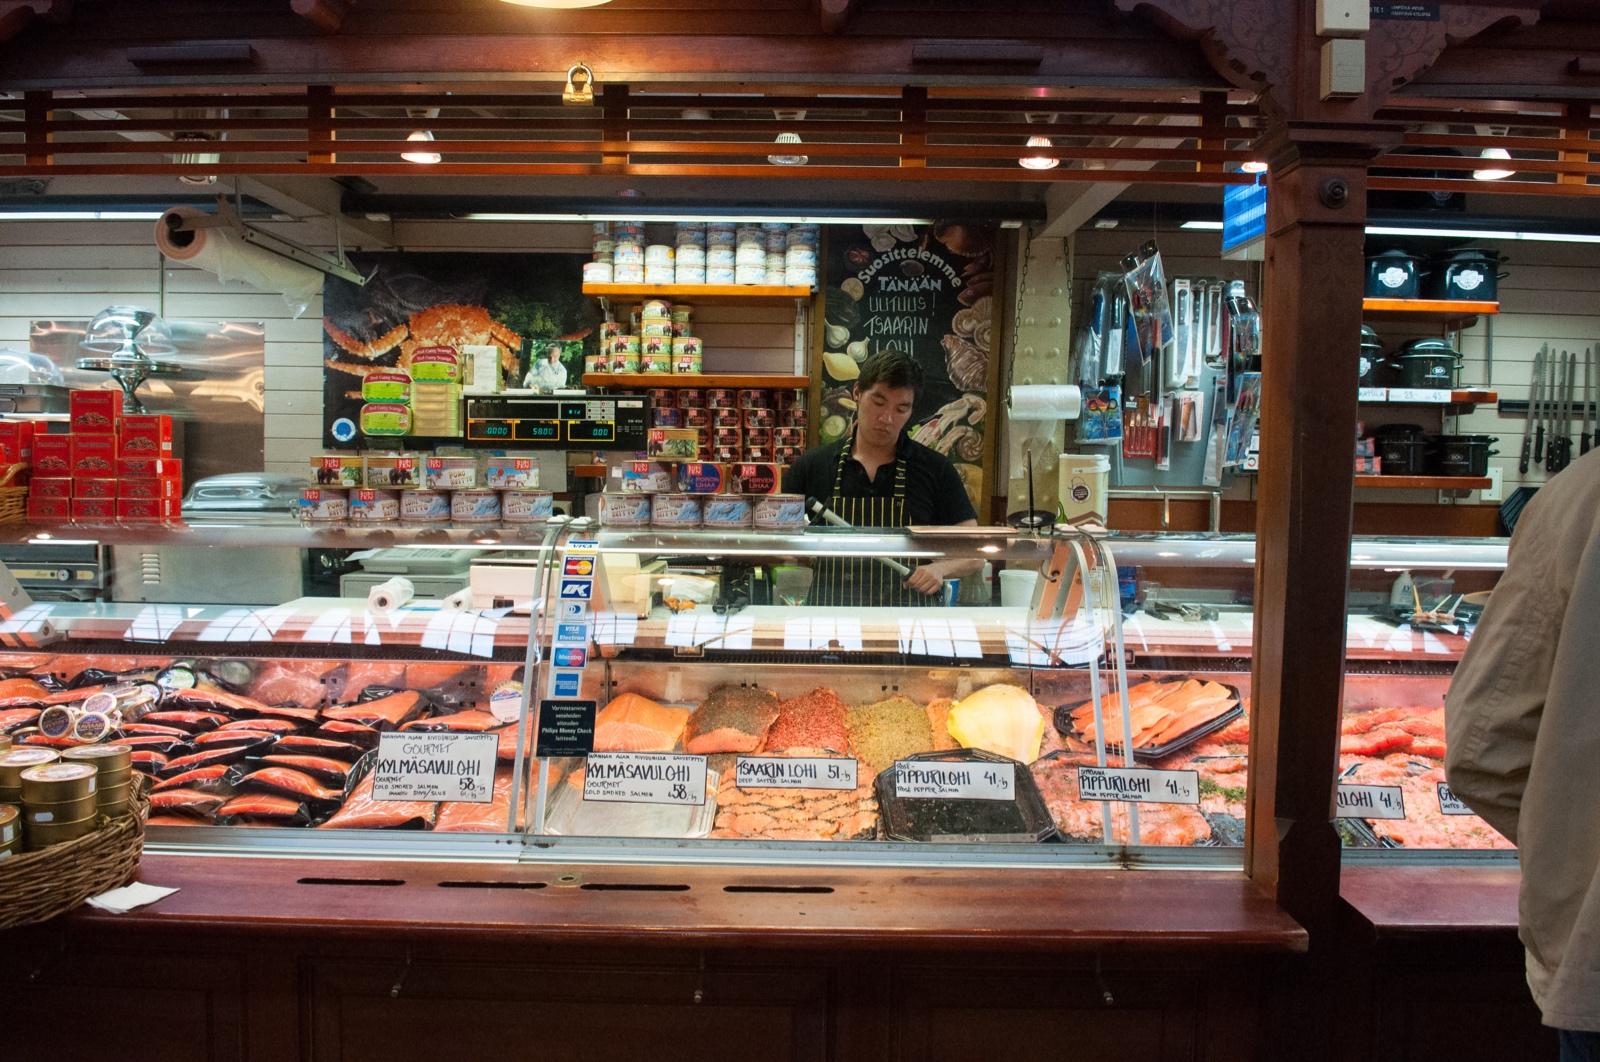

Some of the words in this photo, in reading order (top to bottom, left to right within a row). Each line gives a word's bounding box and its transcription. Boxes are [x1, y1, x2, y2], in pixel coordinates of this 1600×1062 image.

[857, 246, 962, 288] Suosittelemme
[878, 274, 942, 293] TÄNÄÄN
[869, 295, 926, 312] UUTUUS
[863, 315, 929, 338] TSAARIN
[403, 742, 454, 756] GOURMET
[377, 756, 480, 776] KYLMÄSAVULOHI
[587, 761, 690, 782] KYLMÄSAVULOHI
[737, 760, 785, 779] TSAARIN
[788, 764, 817, 779] LOHI
[376, 776, 405, 784] GOURMET
[587, 780, 623, 789] GOURMET
[896, 770, 971, 787] PIPPURILOHI
[1080, 775, 1150, 793] PIPPURILOHI
